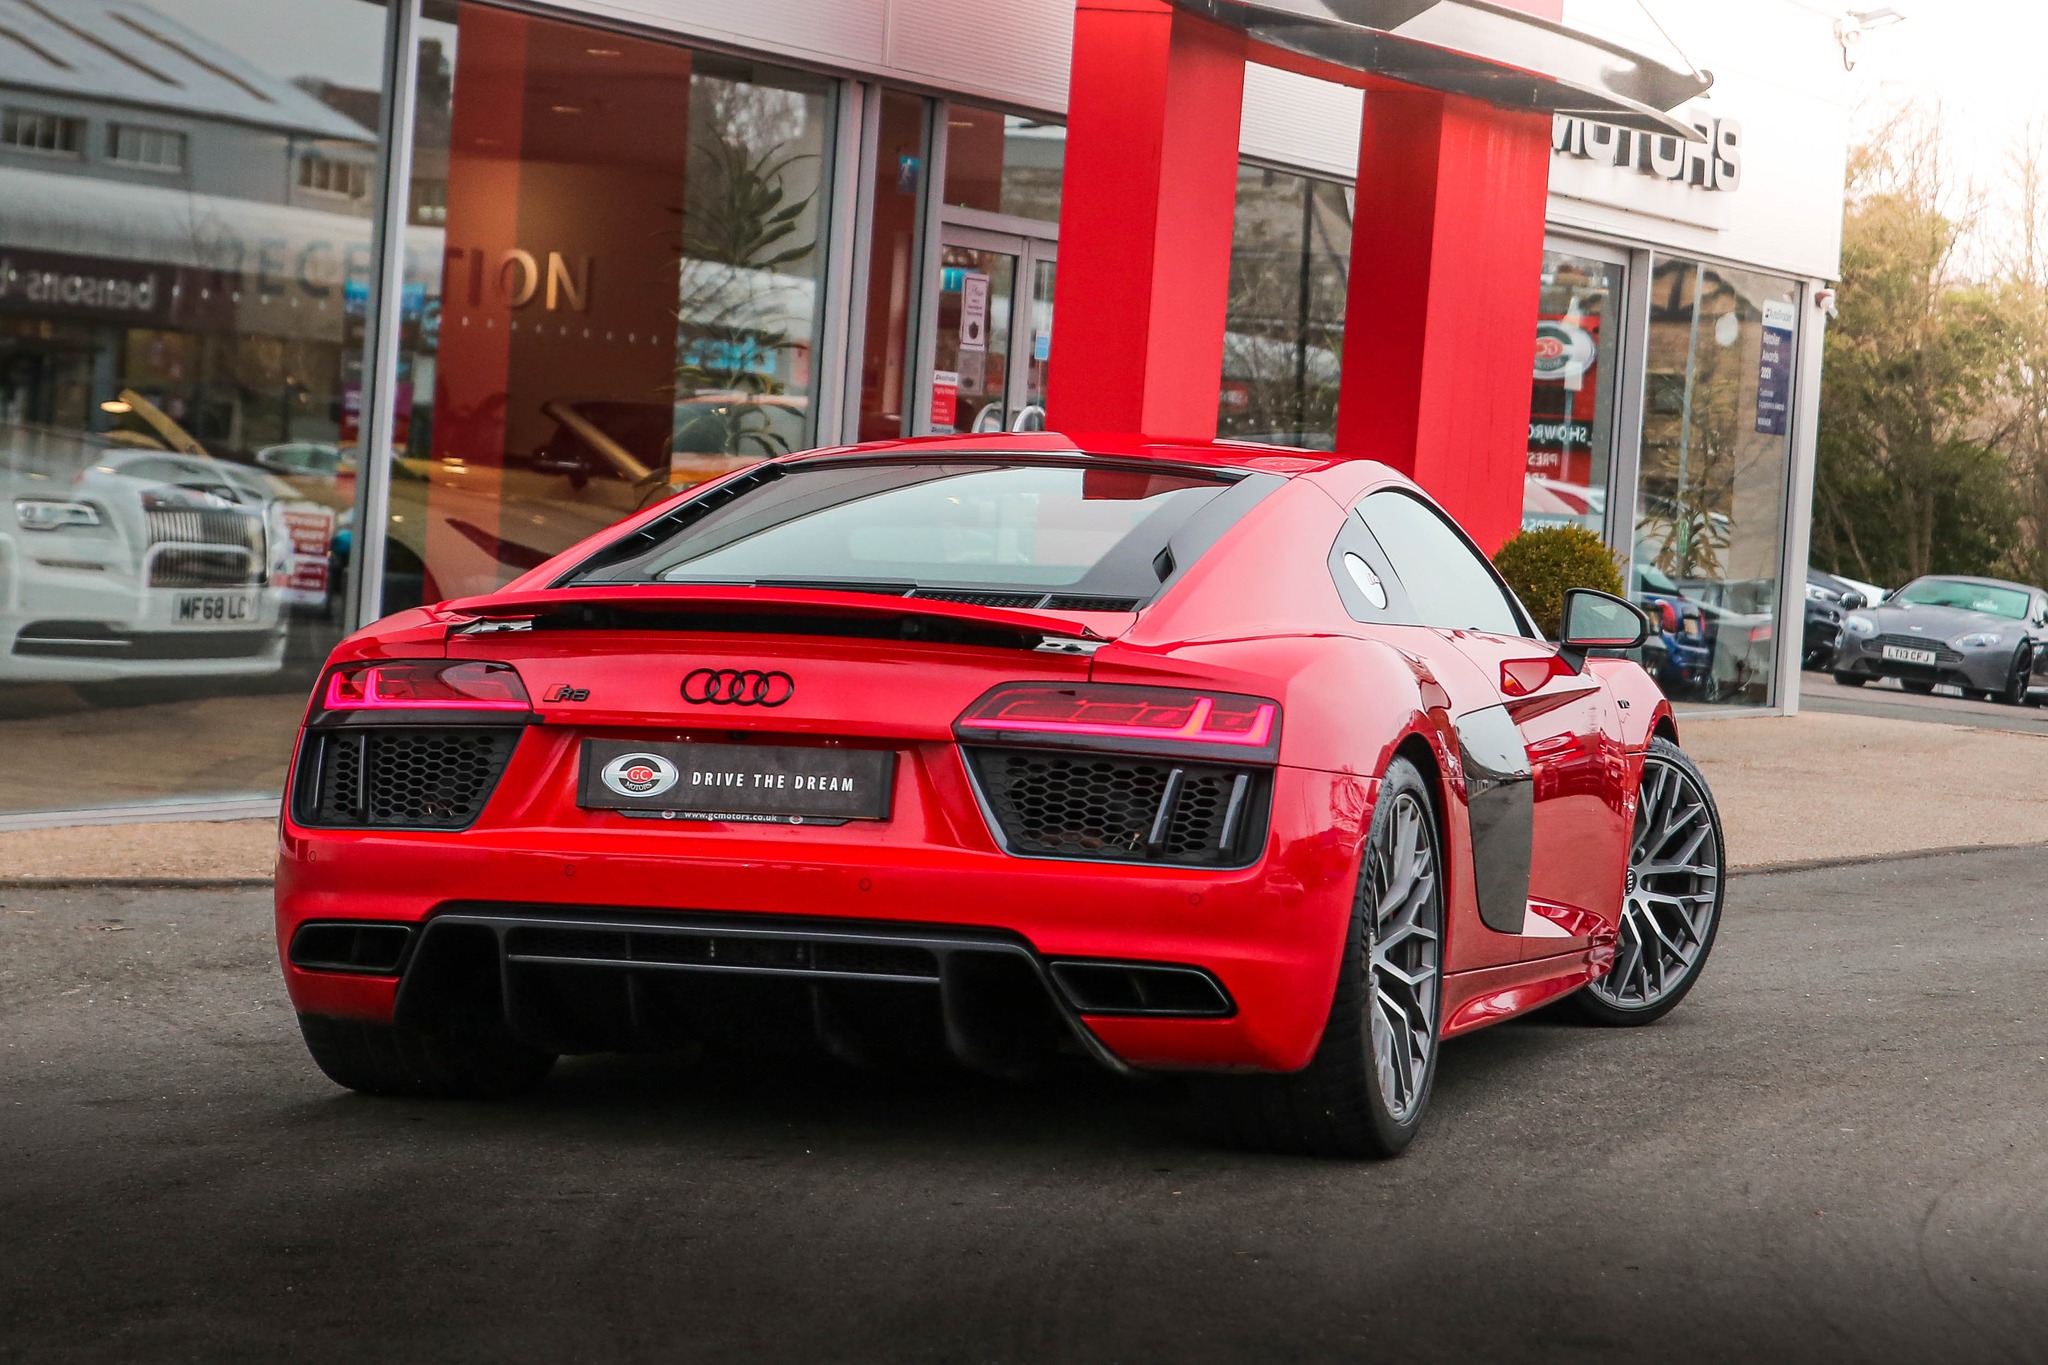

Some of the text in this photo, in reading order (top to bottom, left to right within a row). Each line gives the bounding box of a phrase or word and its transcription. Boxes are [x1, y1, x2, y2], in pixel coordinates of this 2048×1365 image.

[179, 596, 224, 619] MF68
[546, 685, 591, 702] R8
[630, 769, 649, 781] GC
[692, 771, 854, 792] DRIVE THE DREAM
[625, 781, 653, 791] MOTORS
[684, 811, 778, 822] www.gcmotors.co.uk
